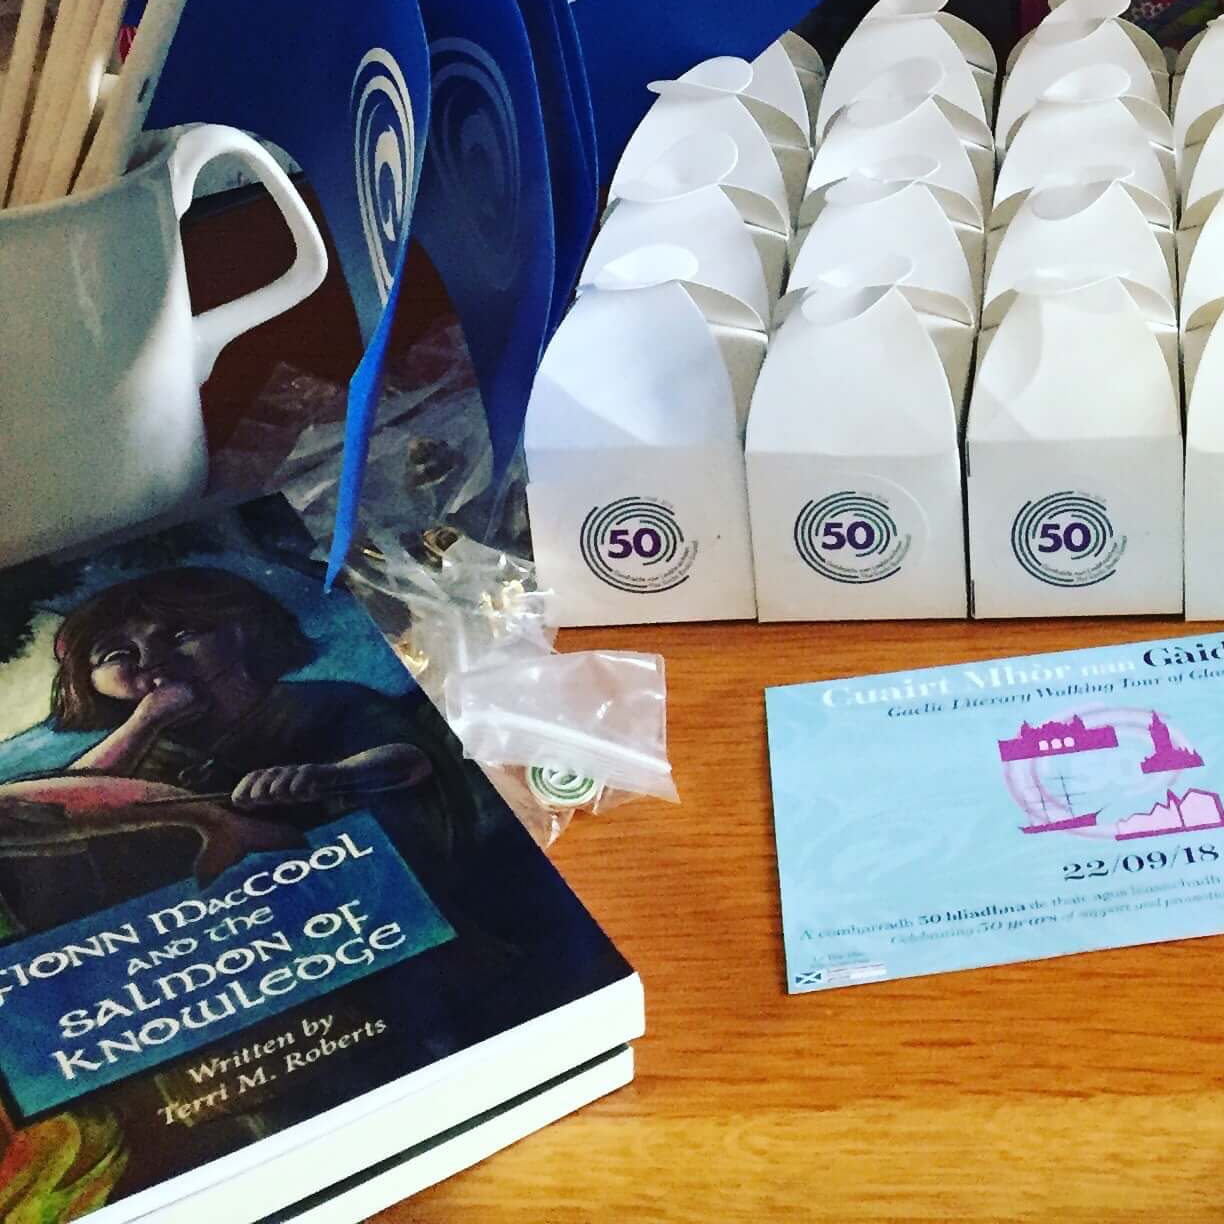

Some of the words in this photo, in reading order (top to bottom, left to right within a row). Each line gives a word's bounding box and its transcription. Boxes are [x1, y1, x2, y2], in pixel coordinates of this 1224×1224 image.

[607, 529, 662, 559] 50
[821, 521, 876, 551] 50
[1038, 522, 1092, 553] 50
[822, 677, 951, 709] Cuairt
[1037, 679, 1114, 700] Walking
[1121, 677, 1160, 690] Tour
[1062, 843, 1220, 882] 22/09/18
[917, 914, 942, 926] 50
[58, 931, 290, 1039] SALMON
[303, 898, 369, 942] OF
[188, 1028, 295, 1085] Written
[302, 1011, 335, 1045] by
[156, 1085, 228, 1127] Terri
[238, 1067, 271, 1102] M.
[285, 1016, 387, 1075] Roberts
